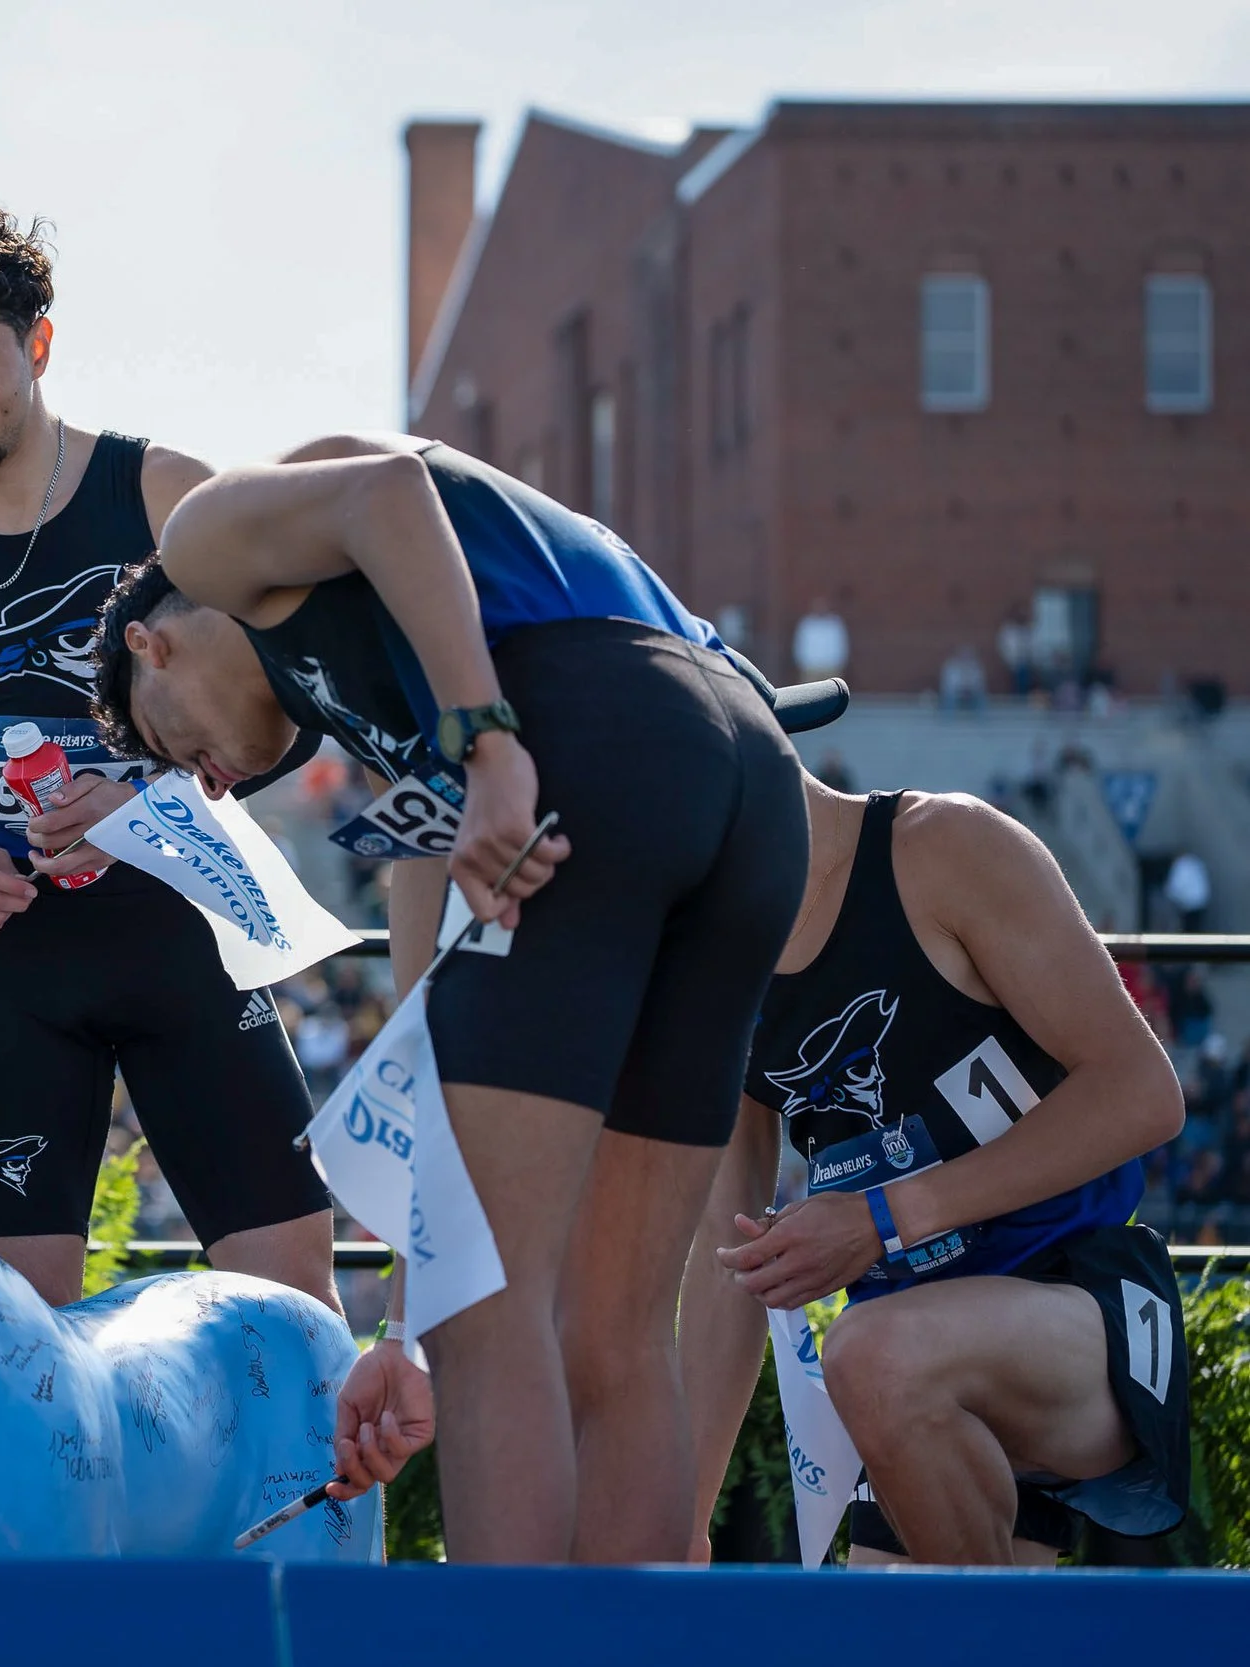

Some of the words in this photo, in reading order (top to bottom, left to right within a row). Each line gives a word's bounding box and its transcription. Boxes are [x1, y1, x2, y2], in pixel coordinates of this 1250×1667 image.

[53, 735, 95, 747] RELAYS
[375, 791, 460, 852] 25
[128, 819, 259, 941] CHAMPION
[152, 795, 244, 871] Drake
[237, 874, 292, 951] RELAYS
[238, 1010, 278, 1031] adidas
[968, 1056, 1025, 1124] 1
[812, 1163, 843, 1184] Drake
[843, 1154, 872, 1174] RELAYS
[1139, 1298, 1158, 1388] 1
